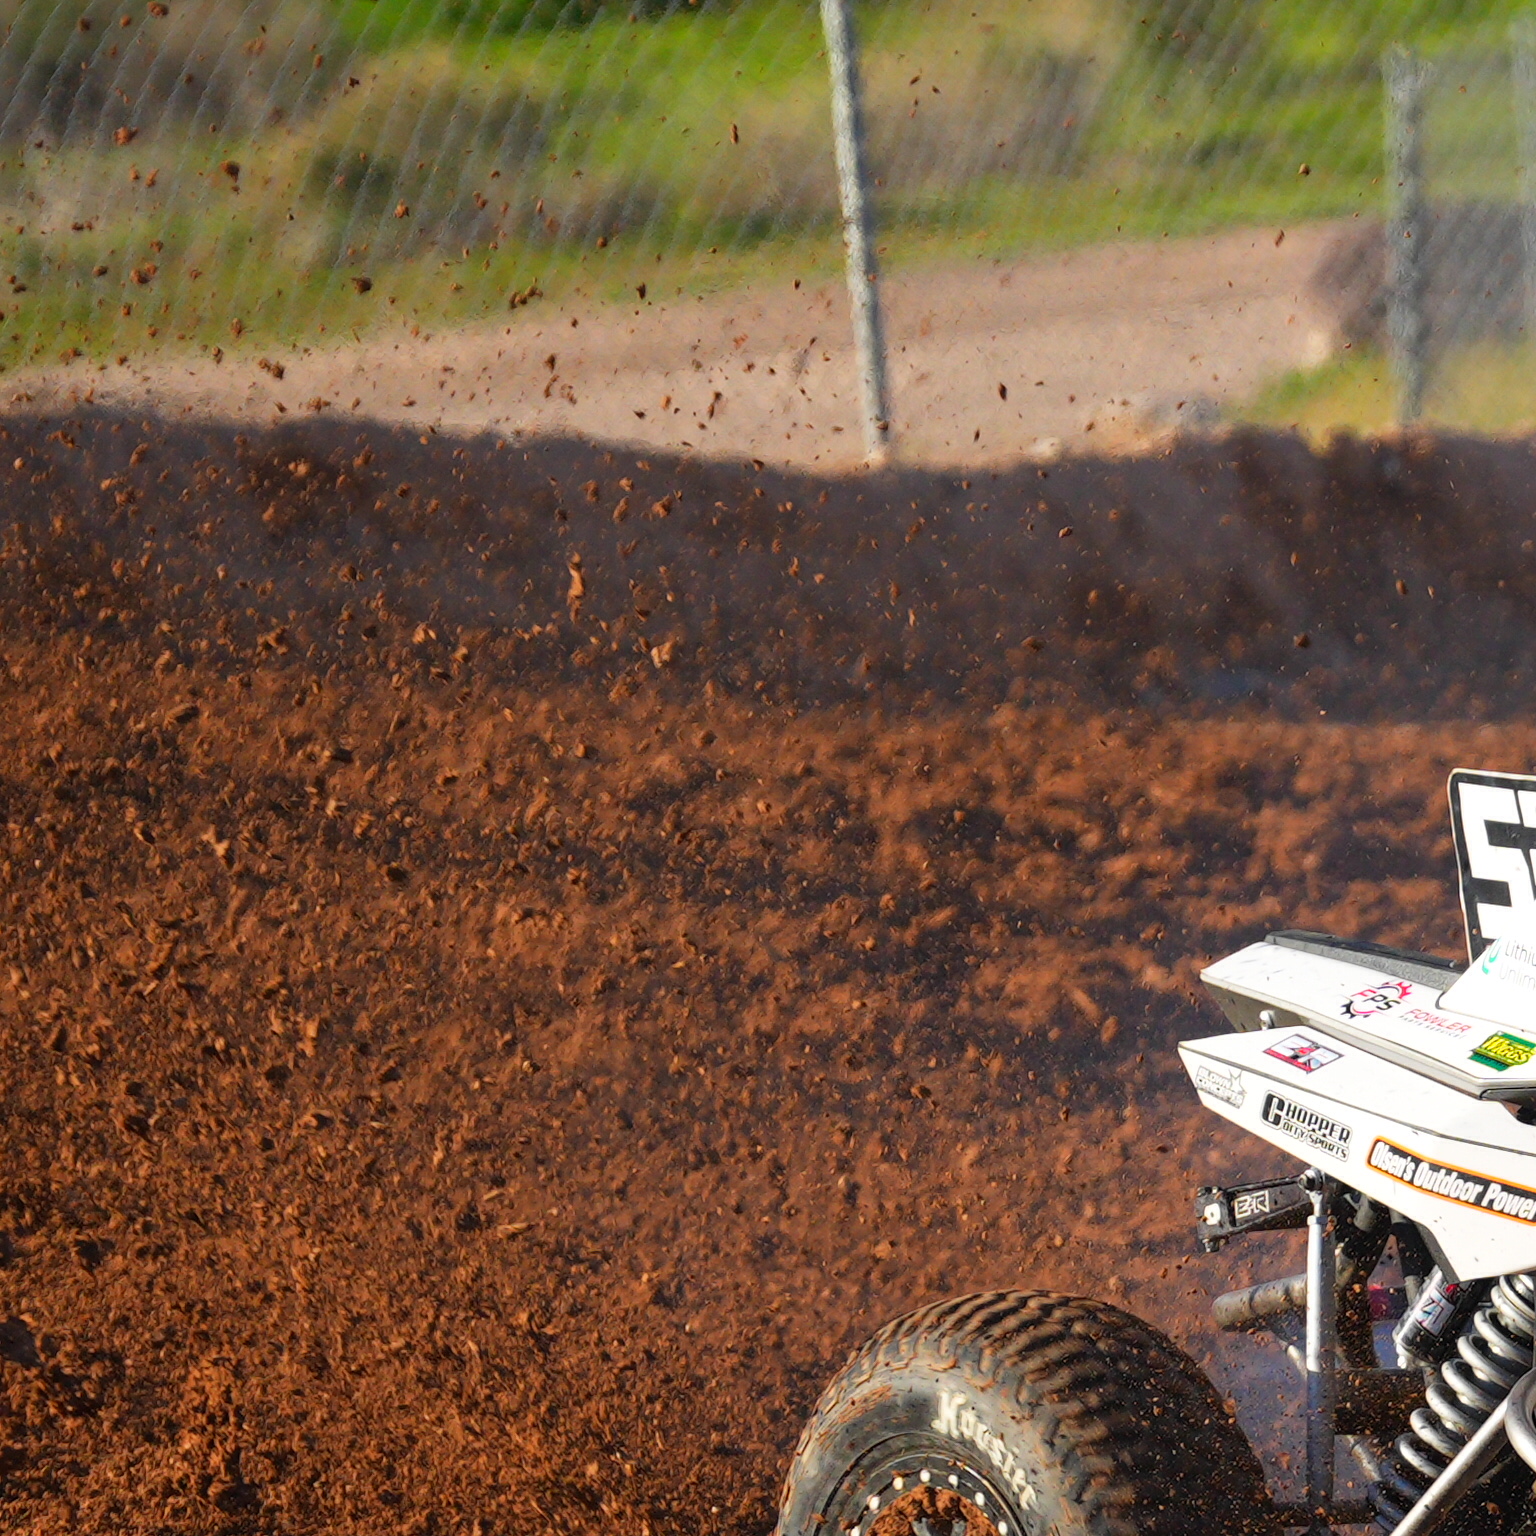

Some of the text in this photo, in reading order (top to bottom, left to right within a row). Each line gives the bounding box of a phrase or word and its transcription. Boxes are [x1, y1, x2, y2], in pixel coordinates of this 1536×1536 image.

[1350, 988, 1401, 1011] FPS
[1404, 1008, 1472, 1033] FOWLER
[1261, 1091, 1351, 1143] CHOPPER
[1308, 1132, 1349, 1161] SPORTS
[1370, 1141, 1416, 1182] Olsen's
[1413, 1162, 1484, 1203] Outdoor
